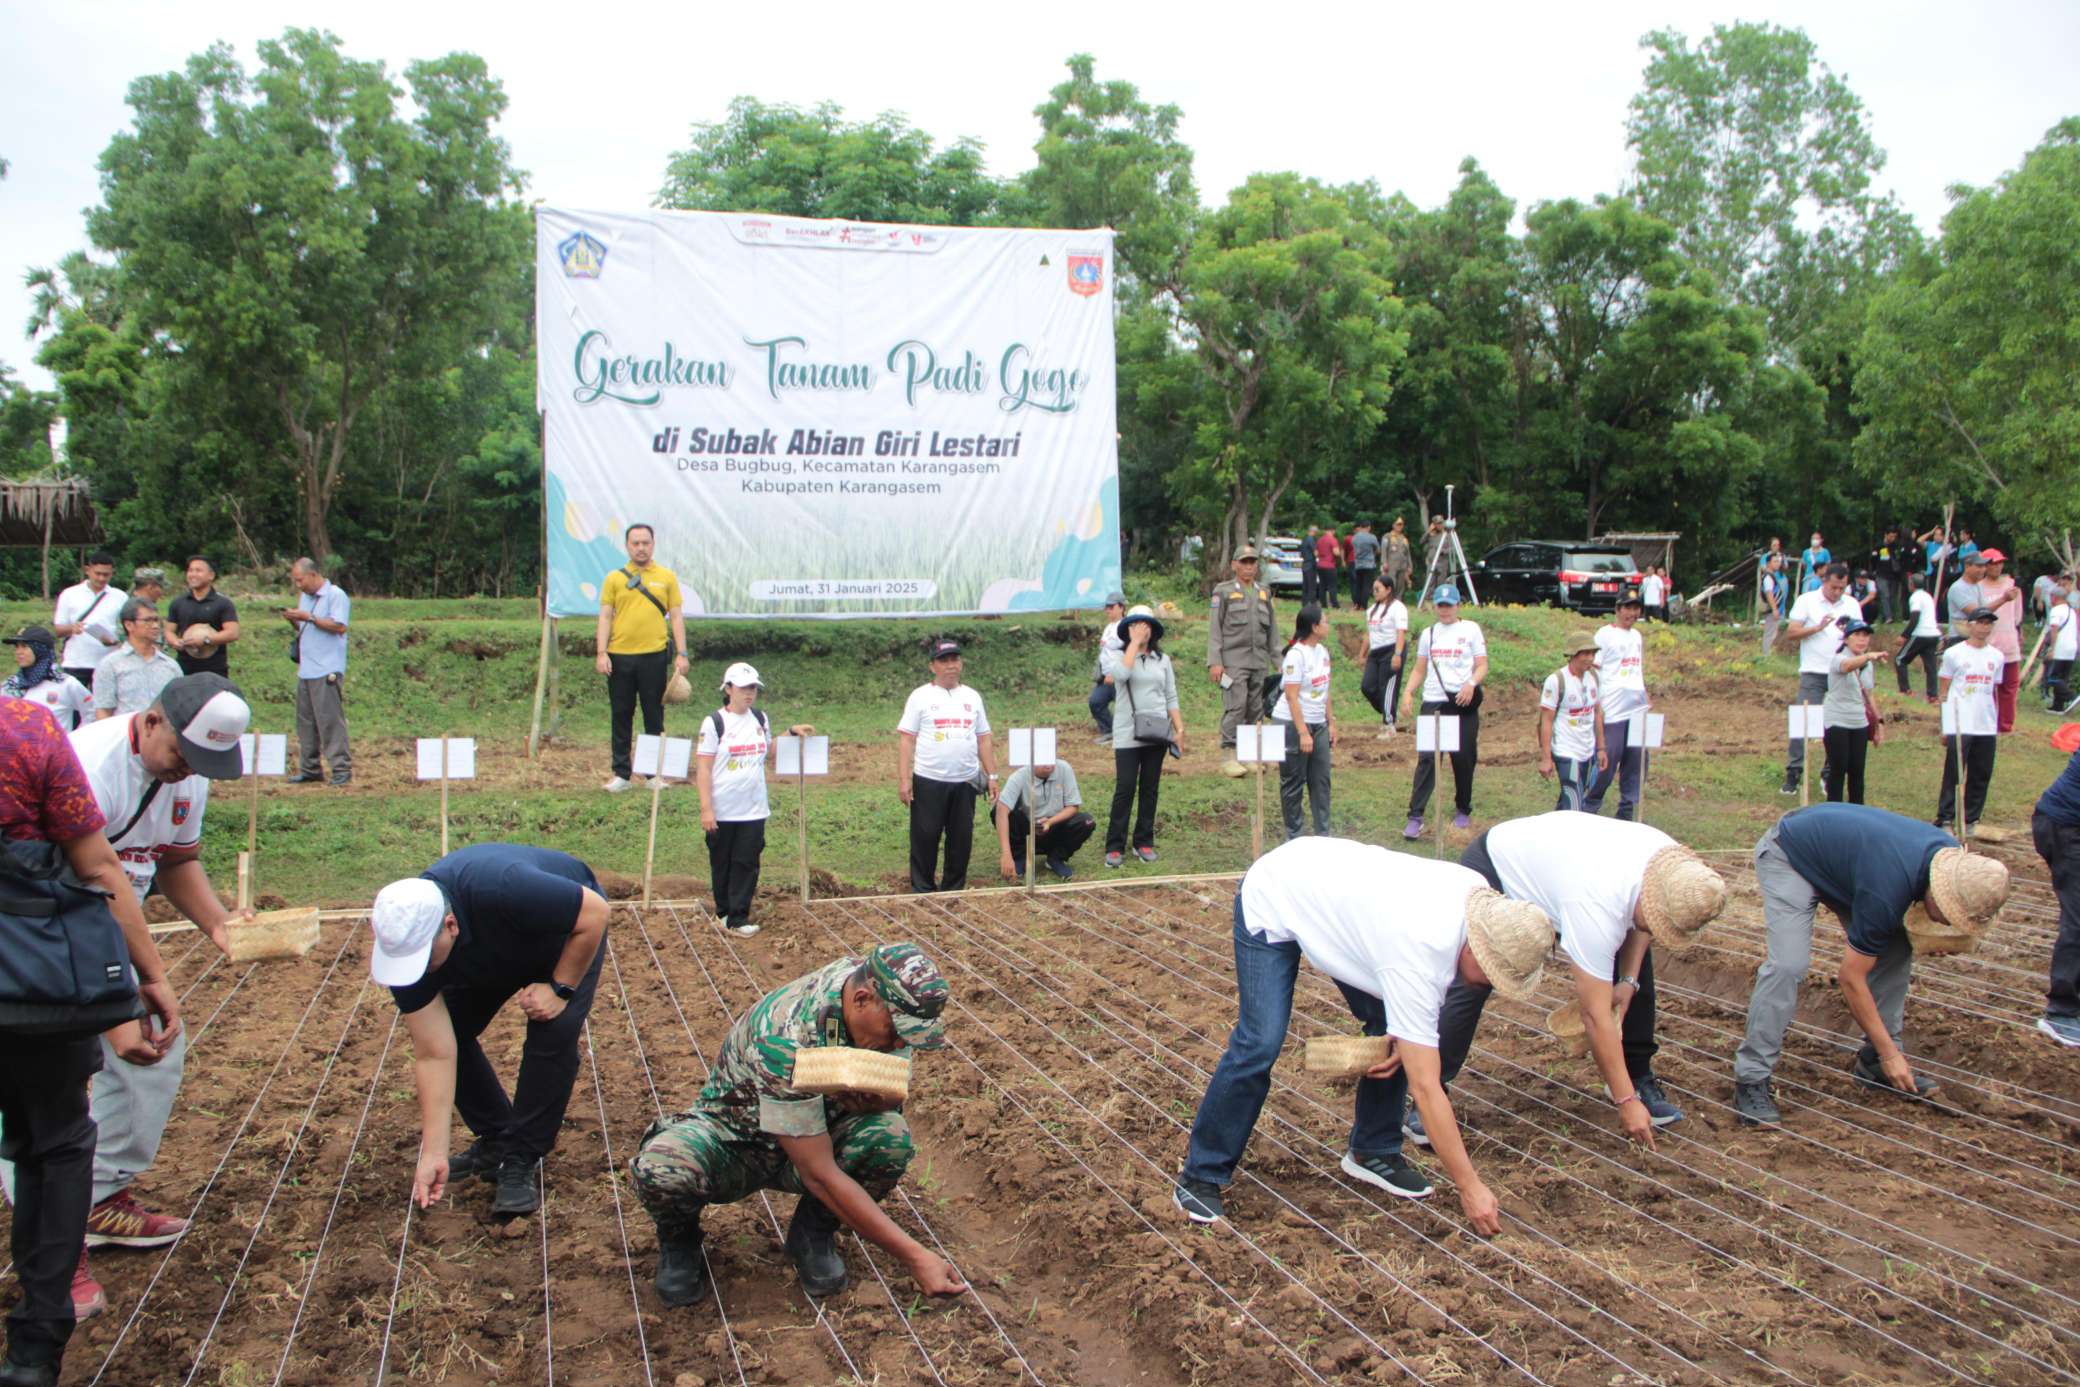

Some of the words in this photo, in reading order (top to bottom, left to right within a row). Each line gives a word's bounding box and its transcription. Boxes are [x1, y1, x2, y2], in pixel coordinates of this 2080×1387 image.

[573, 329, 733, 406] Gerakan
[743, 336, 873, 400] Tanam
[887, 339, 986, 407] Padi
[999, 342, 1089, 412] Gogo
[652, 426, 680, 453] di
[689, 427, 778, 454] Subak
[786, 429, 865, 455] Abian
[875, 430, 921, 457] Giri
[929, 430, 1021, 457] Lestari
[677, 458, 719, 471] Desa
[725, 458, 797, 475] Bugbug,
[803, 459, 896, 473] Kecamatan
[902, 460, 1000, 476] Karangasem
[742, 479, 833, 495] Kabupaten
[840, 480, 941, 495] Karangasem
[769, 583, 814, 595] Jumat,
[818, 583, 830, 594] 31
[834, 582, 881, 594] Januari
[886, 582, 918, 594] 2025
